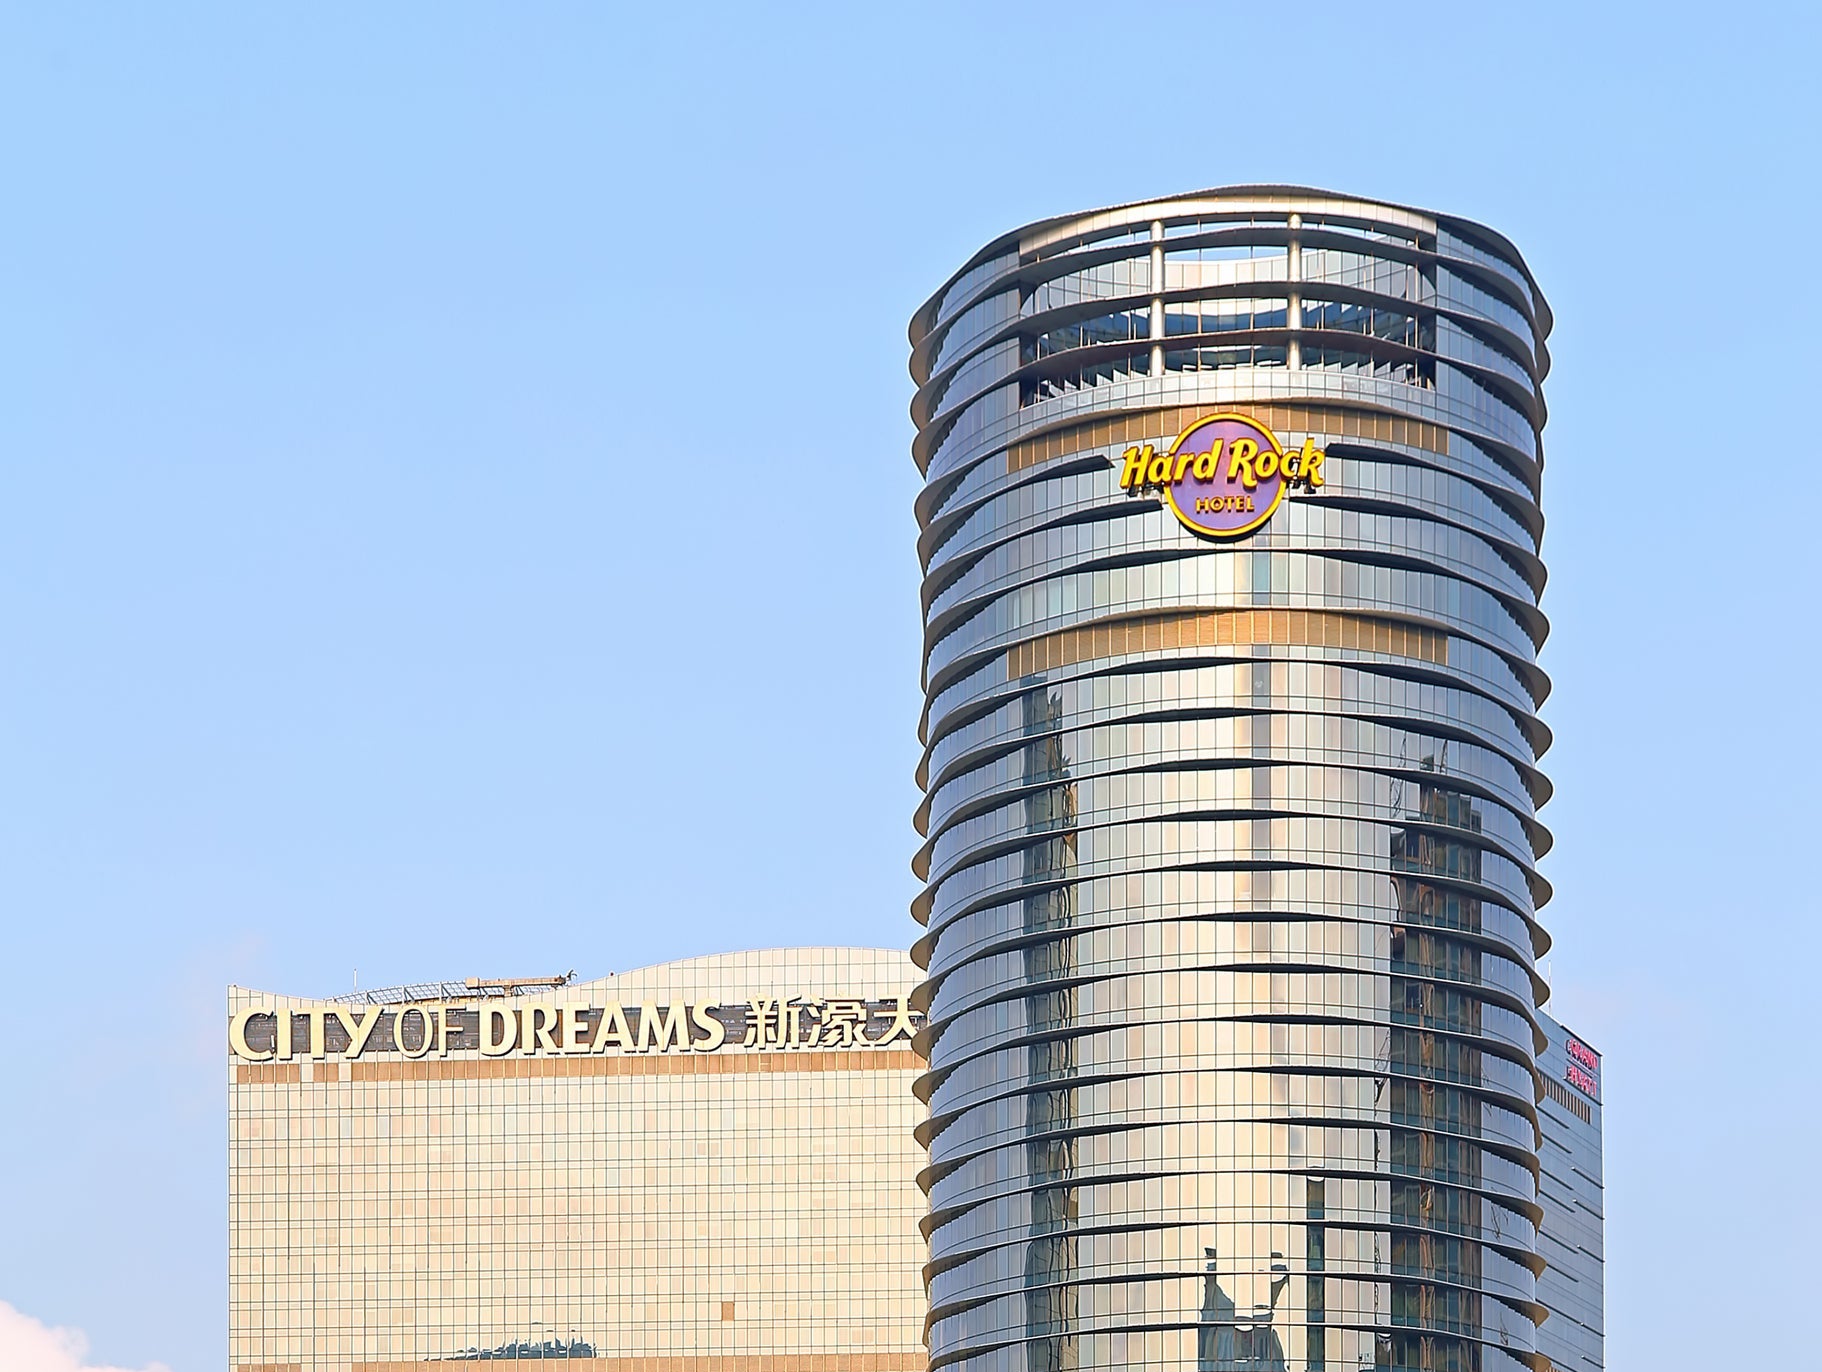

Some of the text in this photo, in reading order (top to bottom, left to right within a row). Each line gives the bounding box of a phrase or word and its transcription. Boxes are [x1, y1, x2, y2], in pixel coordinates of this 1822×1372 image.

[1120, 436, 1325, 489] Hard Rock
[1195, 495, 1255, 514] HOTEL
[229, 1000, 726, 1060] CITY OF DREAMS
